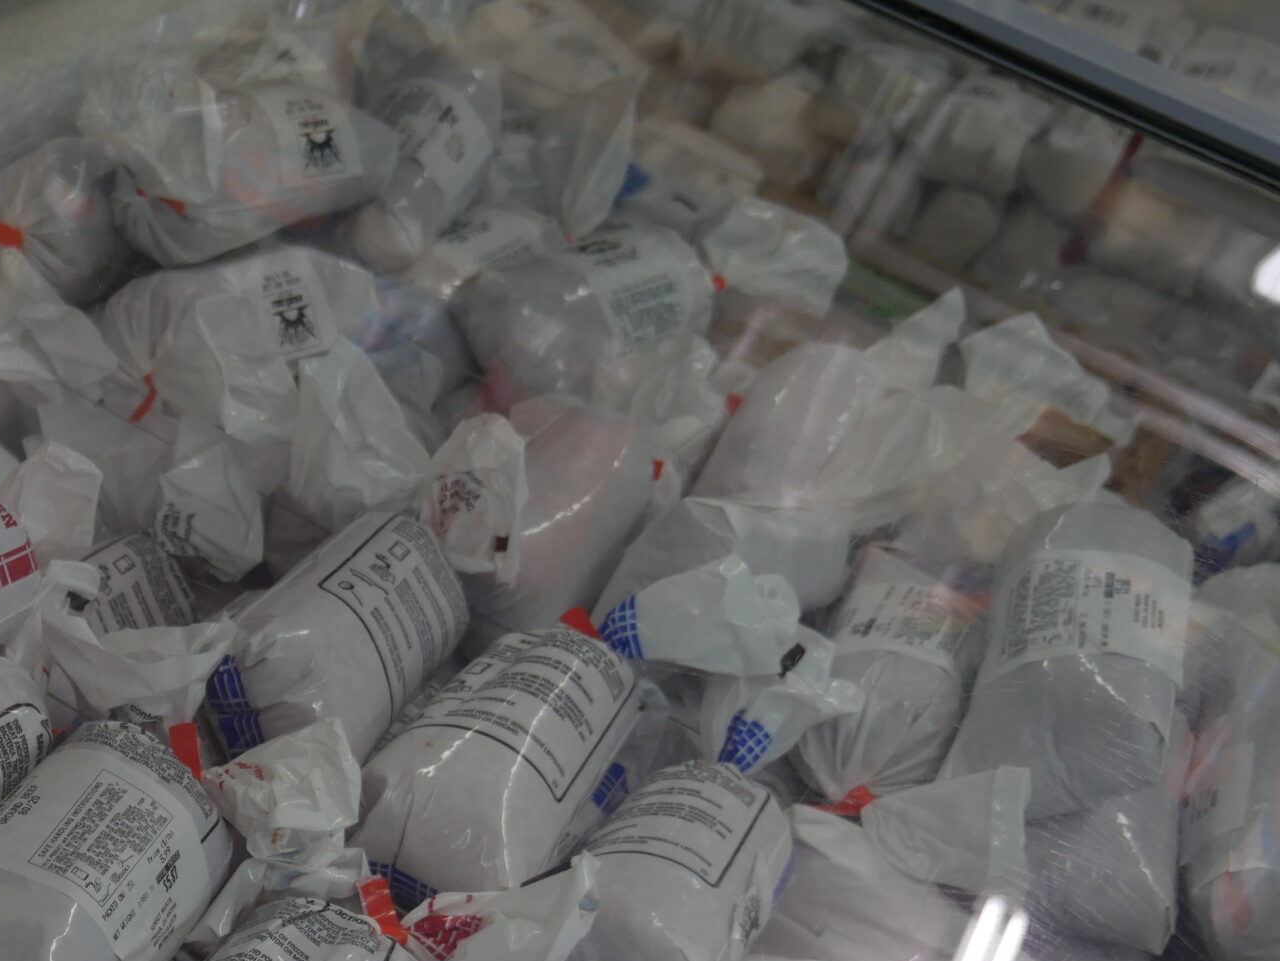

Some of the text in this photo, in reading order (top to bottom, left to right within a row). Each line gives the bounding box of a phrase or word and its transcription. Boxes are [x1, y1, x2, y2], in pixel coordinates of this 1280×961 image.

[36, 778, 107, 860] SAFE HANDLING INSTRUCTIONS
